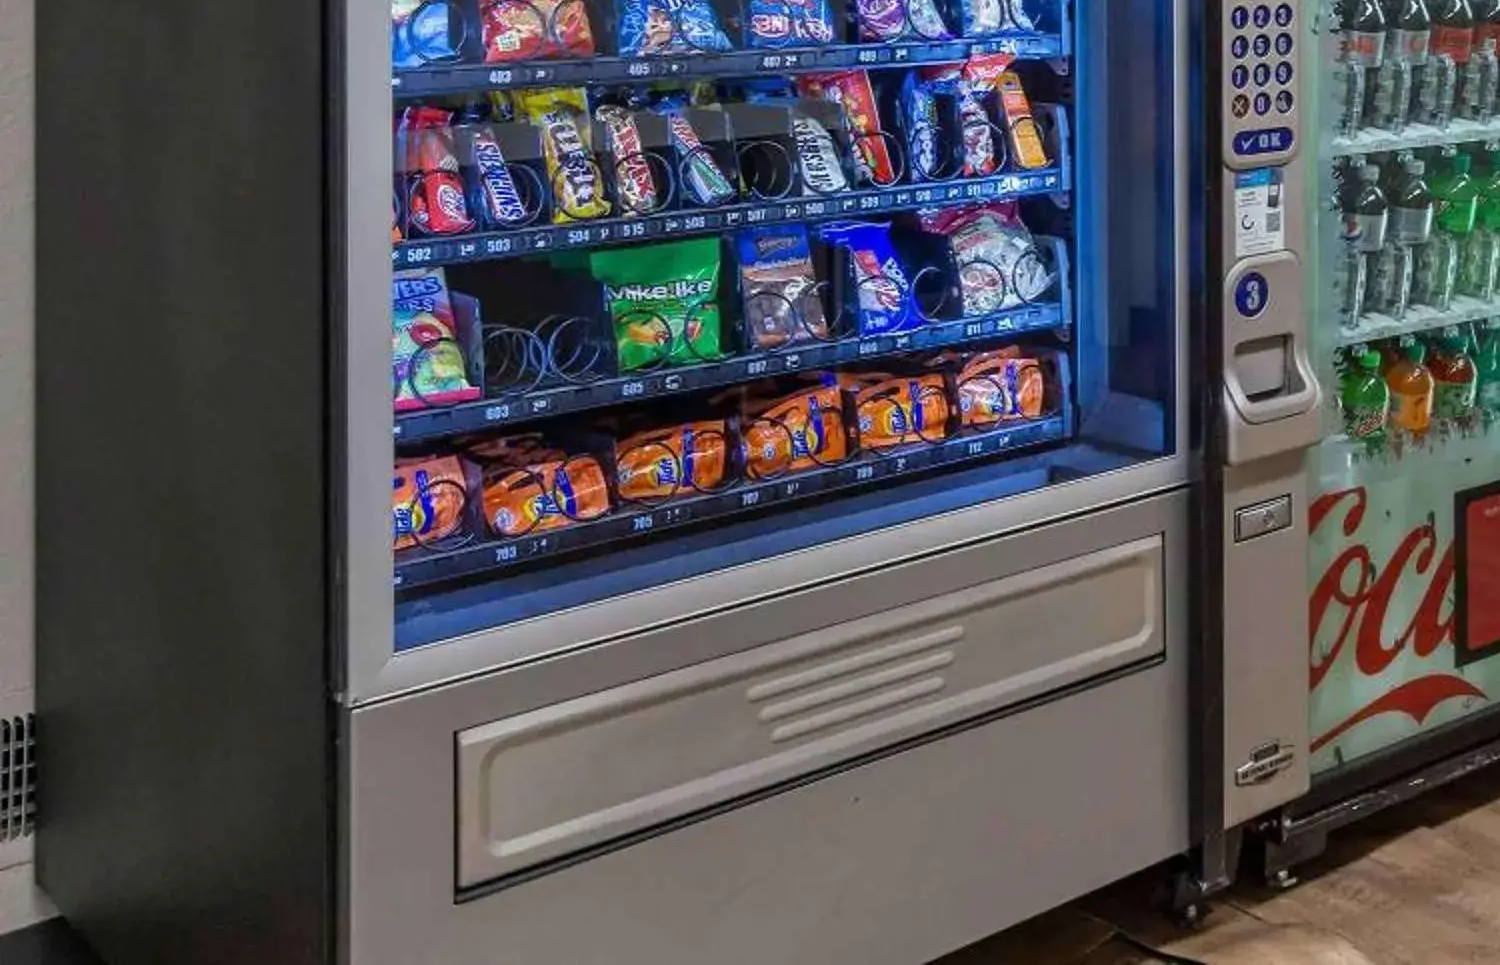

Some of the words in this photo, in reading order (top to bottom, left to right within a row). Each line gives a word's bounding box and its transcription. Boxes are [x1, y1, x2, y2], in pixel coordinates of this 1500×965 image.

[1234, 11, 1242, 26] 1
[1257, 9, 1265, 25] 2
[1279, 7, 1287, 23] 3
[1233, 41, 1242, 56] 4
[1256, 39, 1265, 54] 5
[1279, 37, 1287, 52] 6
[1257, 68, 1265, 83] 8
[1279, 66, 1287, 81] 9
[1258, 97, 1265, 111] 0
[1258, 132, 1281, 148] OK
[487, 240, 511, 253] 503
[407, 248, 431, 262] 502
[1245, 281, 1259, 310] 3
